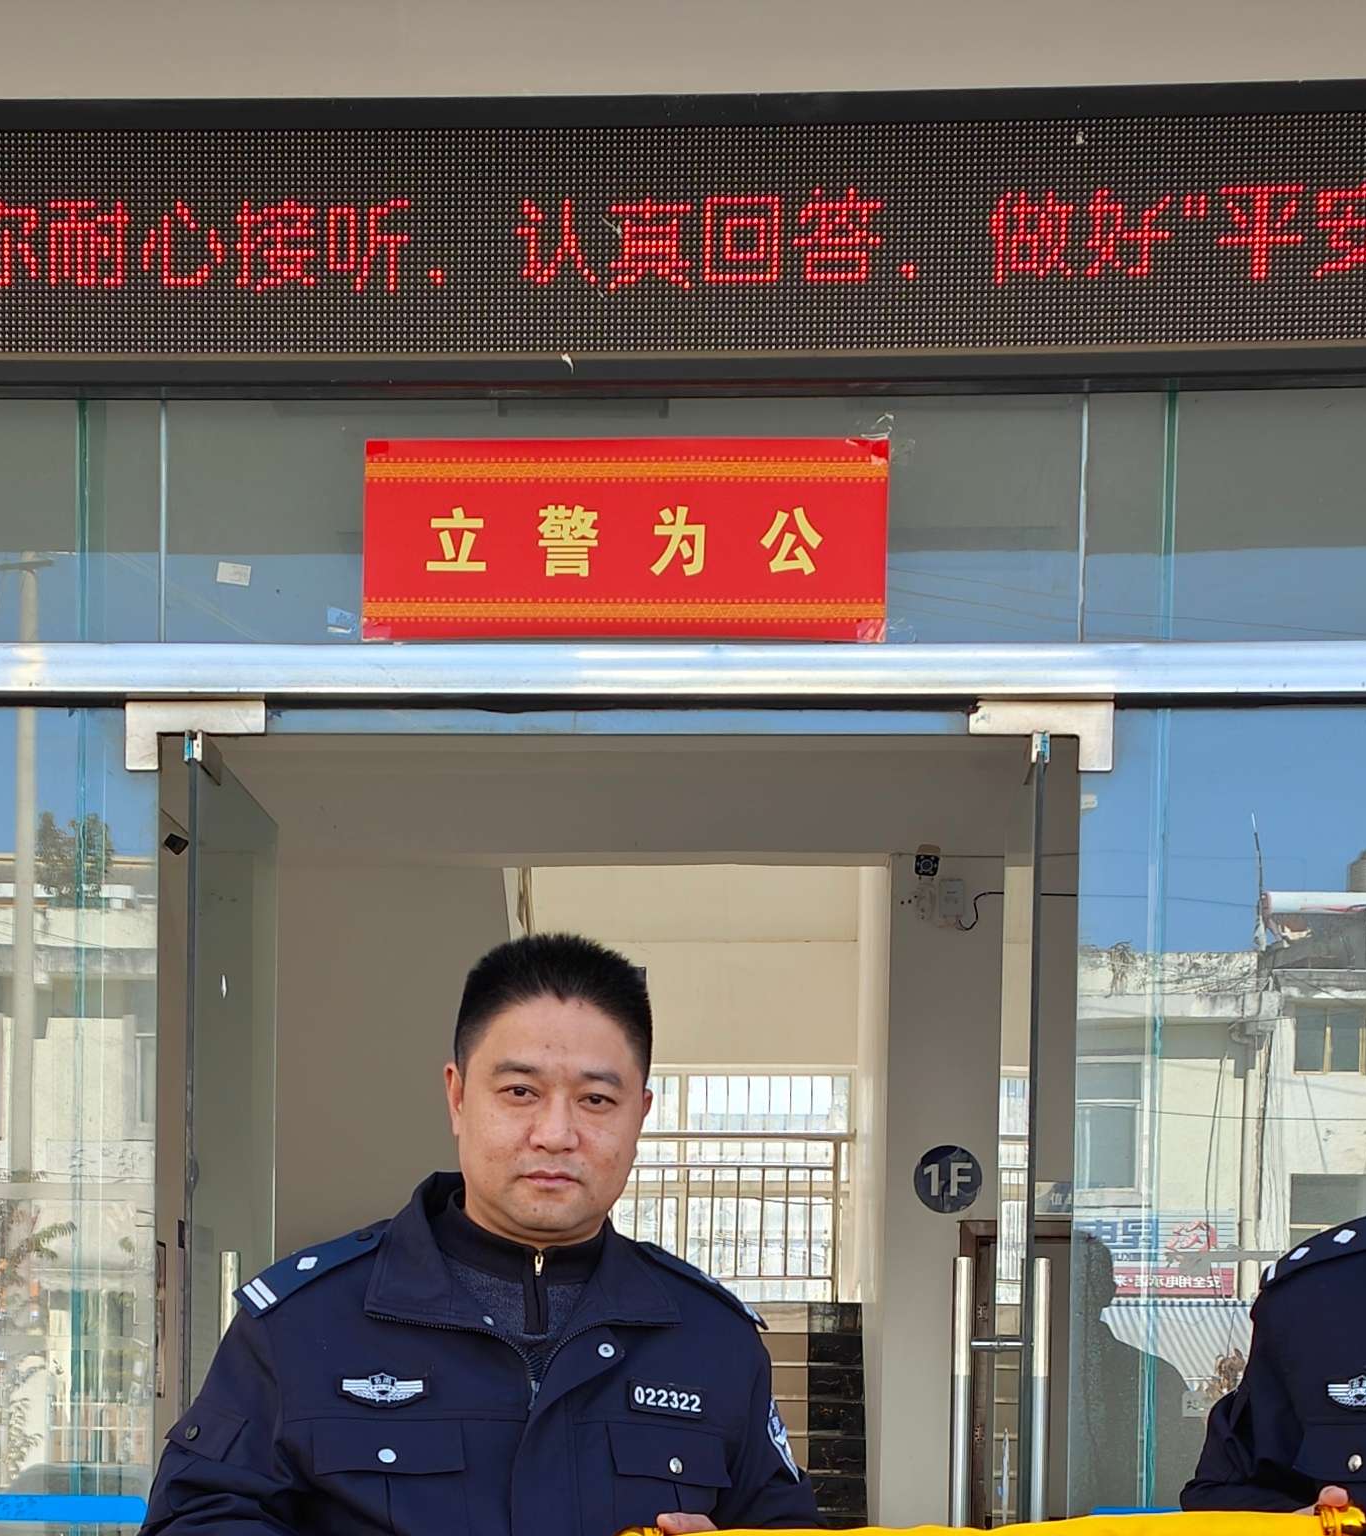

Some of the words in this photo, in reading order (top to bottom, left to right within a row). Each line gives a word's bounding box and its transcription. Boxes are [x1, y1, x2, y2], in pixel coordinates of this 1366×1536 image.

[426, 504, 824, 577] 立警为公
[922, 1162, 973, 1197] 1F
[634, 1386, 703, 1413] 022322
